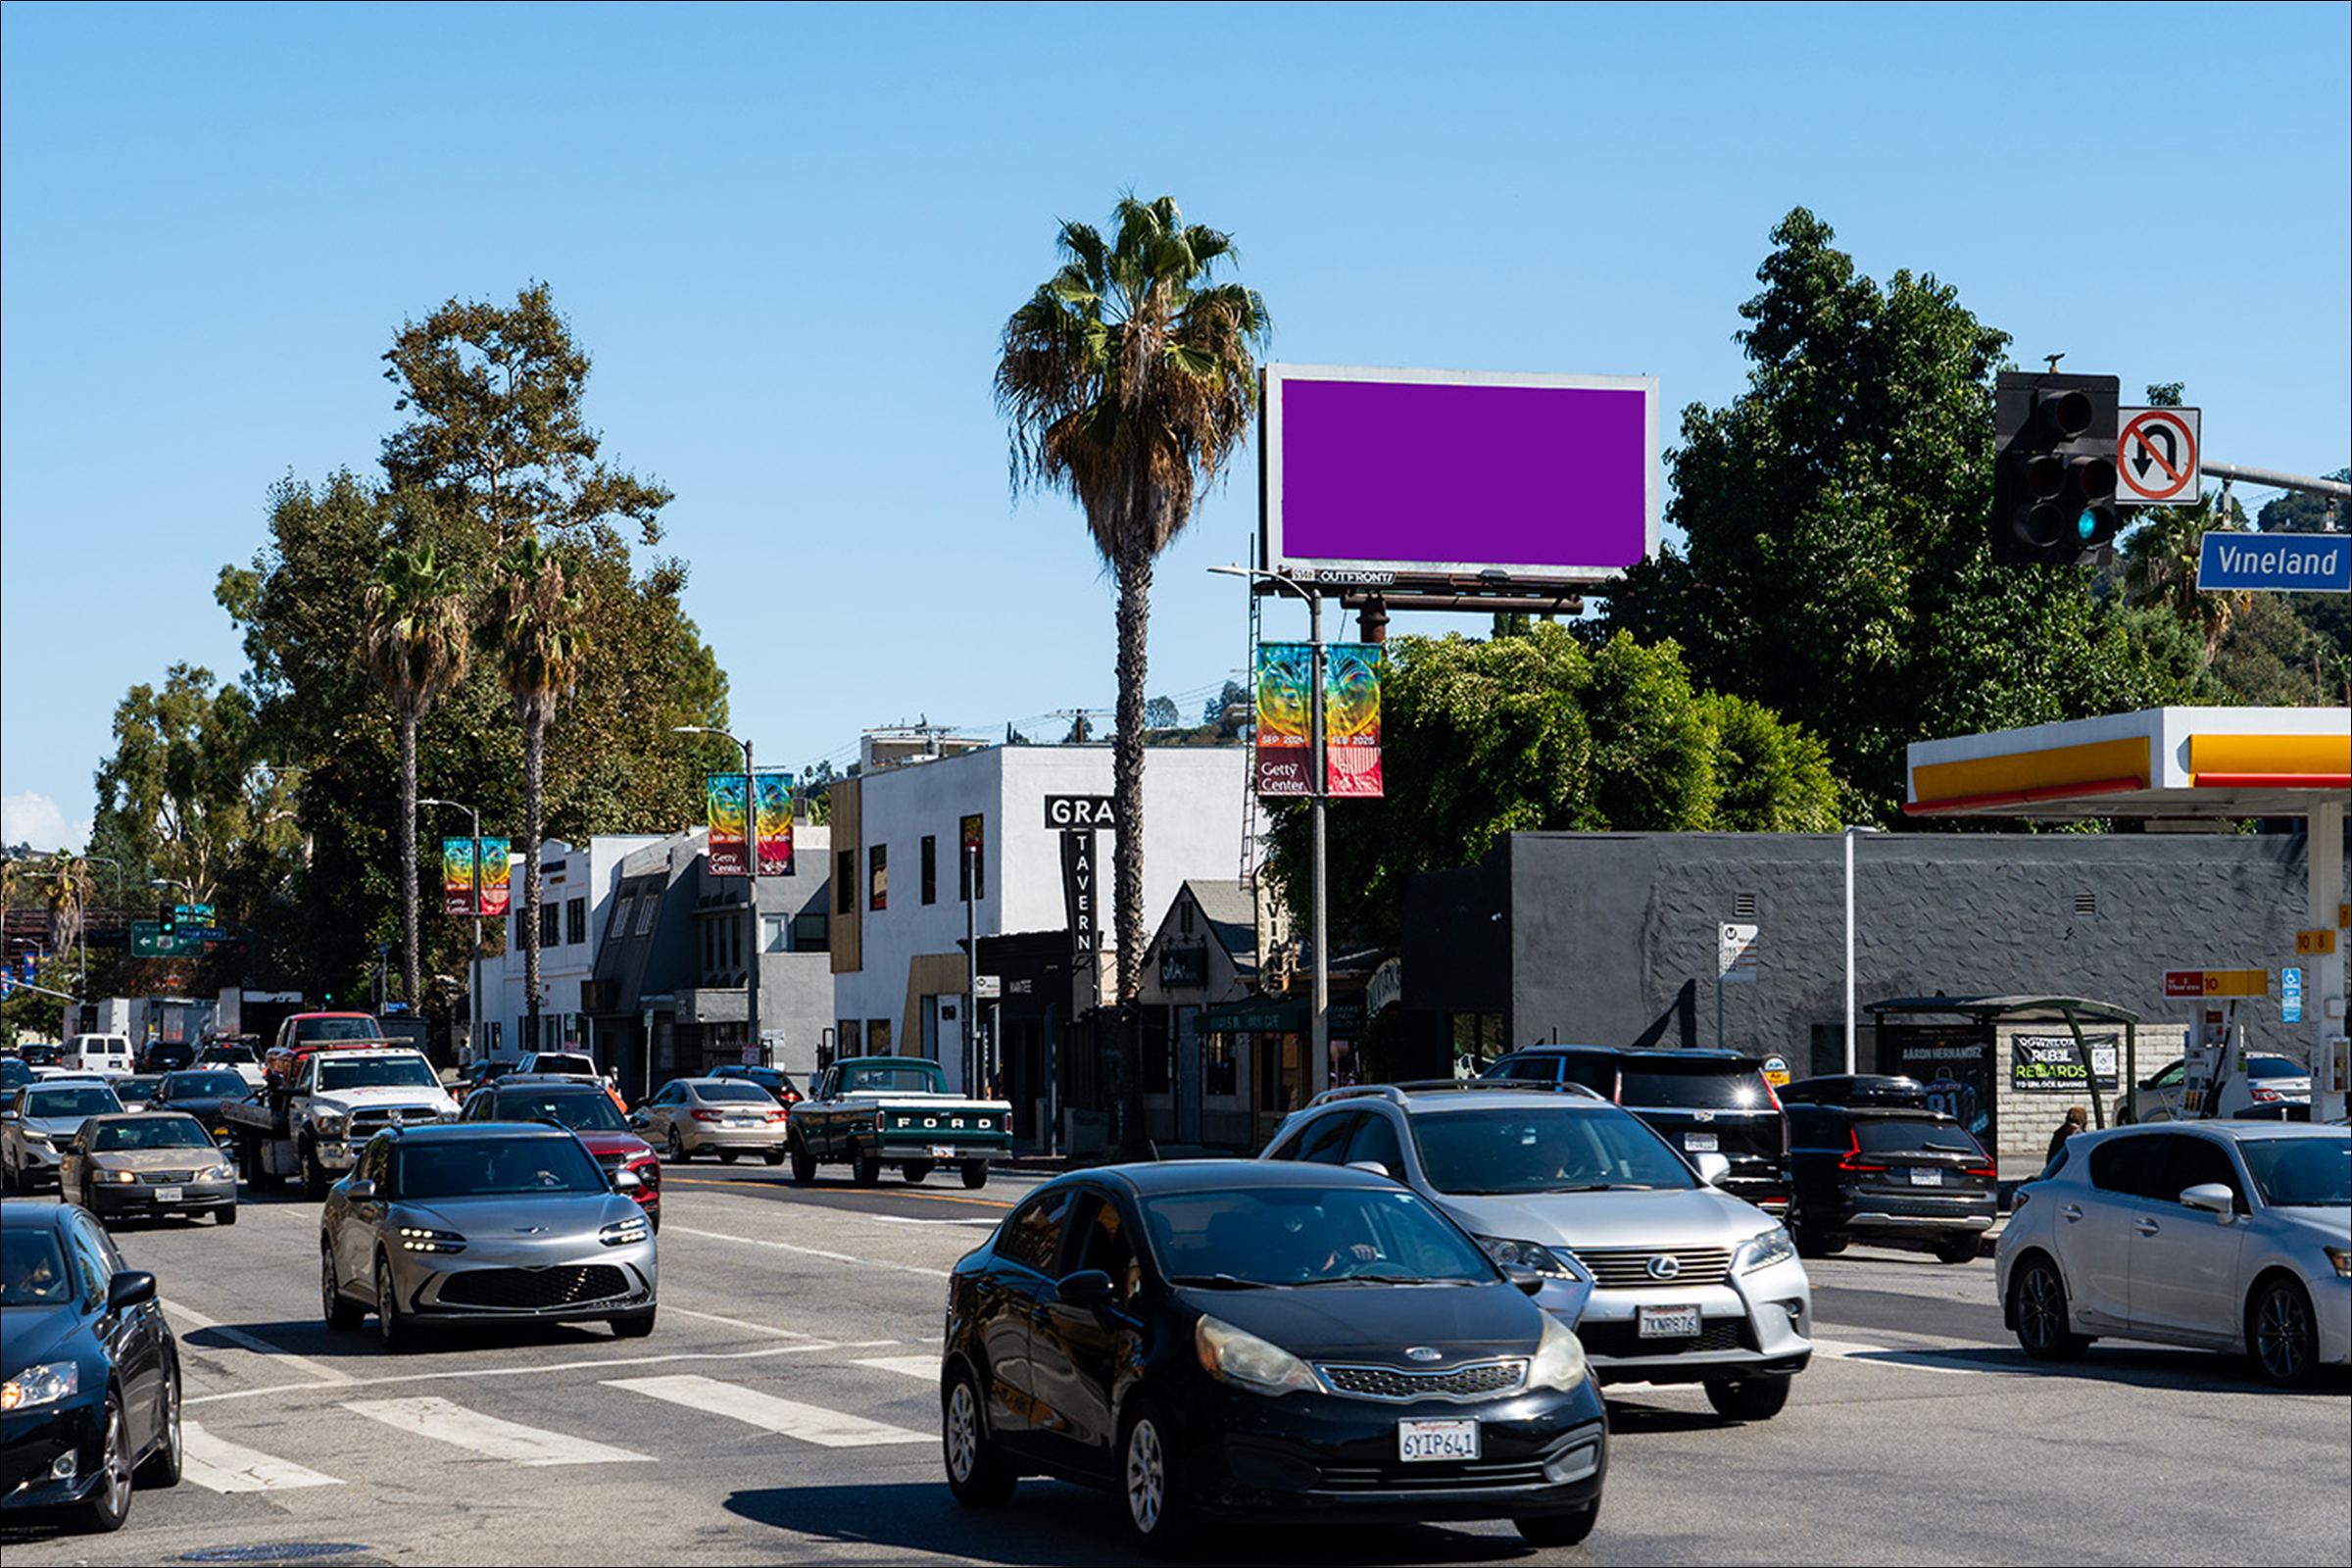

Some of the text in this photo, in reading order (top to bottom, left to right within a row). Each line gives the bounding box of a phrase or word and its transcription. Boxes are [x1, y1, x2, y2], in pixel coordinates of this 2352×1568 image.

[2219, 545, 2338, 575] Vineland
[1262, 734, 1305, 745] SEP 2024
[1332, 735, 1375, 746] FEB 2025
[1261, 761, 1299, 778] Getty
[1261, 777, 1305, 791] Center
[1051, 799, 1116, 824] GRA
[711, 853, 738, 862] Getty
[711, 863, 742, 873] Center
[1076, 835, 1091, 951] TAVERN
[2298, 934, 2310, 950] 10
[2205, 978, 2219, 991] 10
[2019, 1038, 2078, 1047] DOWNLOA
[1902, 1046, 1984, 1060] AARON HERNANDEZ
[2016, 1063, 2088, 1078] REWARDS
[897, 1117, 992, 1129] FORD
[1403, 1433, 1473, 1455] 6YIP641
